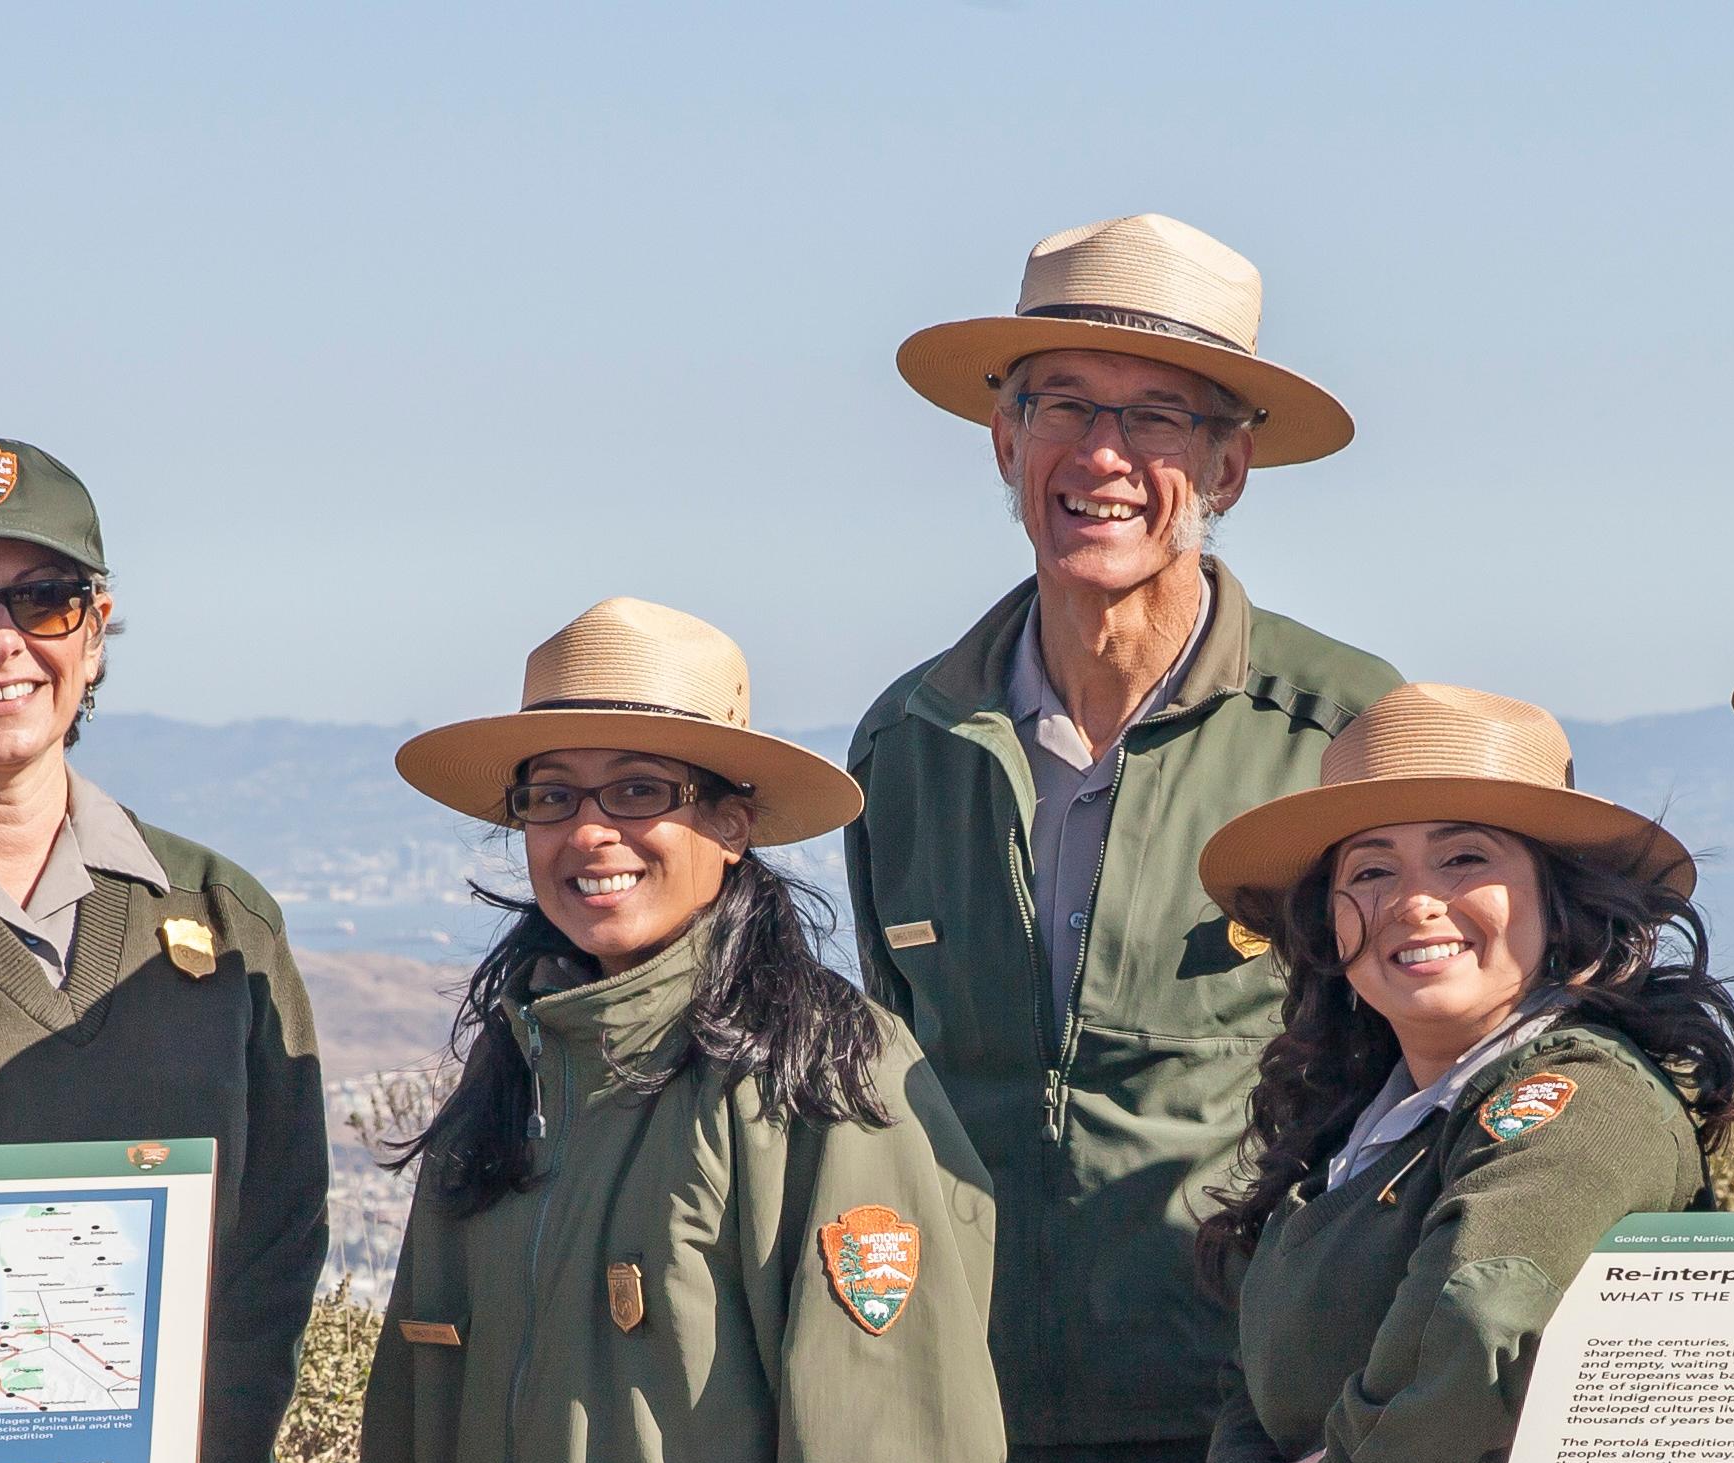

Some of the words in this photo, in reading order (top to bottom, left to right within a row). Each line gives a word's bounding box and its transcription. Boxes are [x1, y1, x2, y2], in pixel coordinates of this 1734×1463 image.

[1518, 1083, 1568, 1092] NATIONAL
[1517, 1092, 1559, 1102] SERVICE
[861, 1232, 911, 1244] NATIONAL
[873, 1243, 899, 1252] PARK
[867, 1251, 907, 1263] SERVICE
[1600, 1291, 1663, 1301] WHAT
[1668, 1291, 1684, 1301] IS
[1691, 1291, 1730, 1301] THE
[1587, 1338, 1623, 1346] Over
[1628, 1338, 1652, 1346] the
[1657, 1338, 1728, 1347] centuries,
[1584, 1349, 1667, 1358] sharpened.
[1673, 1349, 1700, 1357] The
[70, 1413, 132, 1422] Ramaytush
[1561, 1438, 1588, 1446] The
[1593, 1438, 1648, 1446] Portolá
